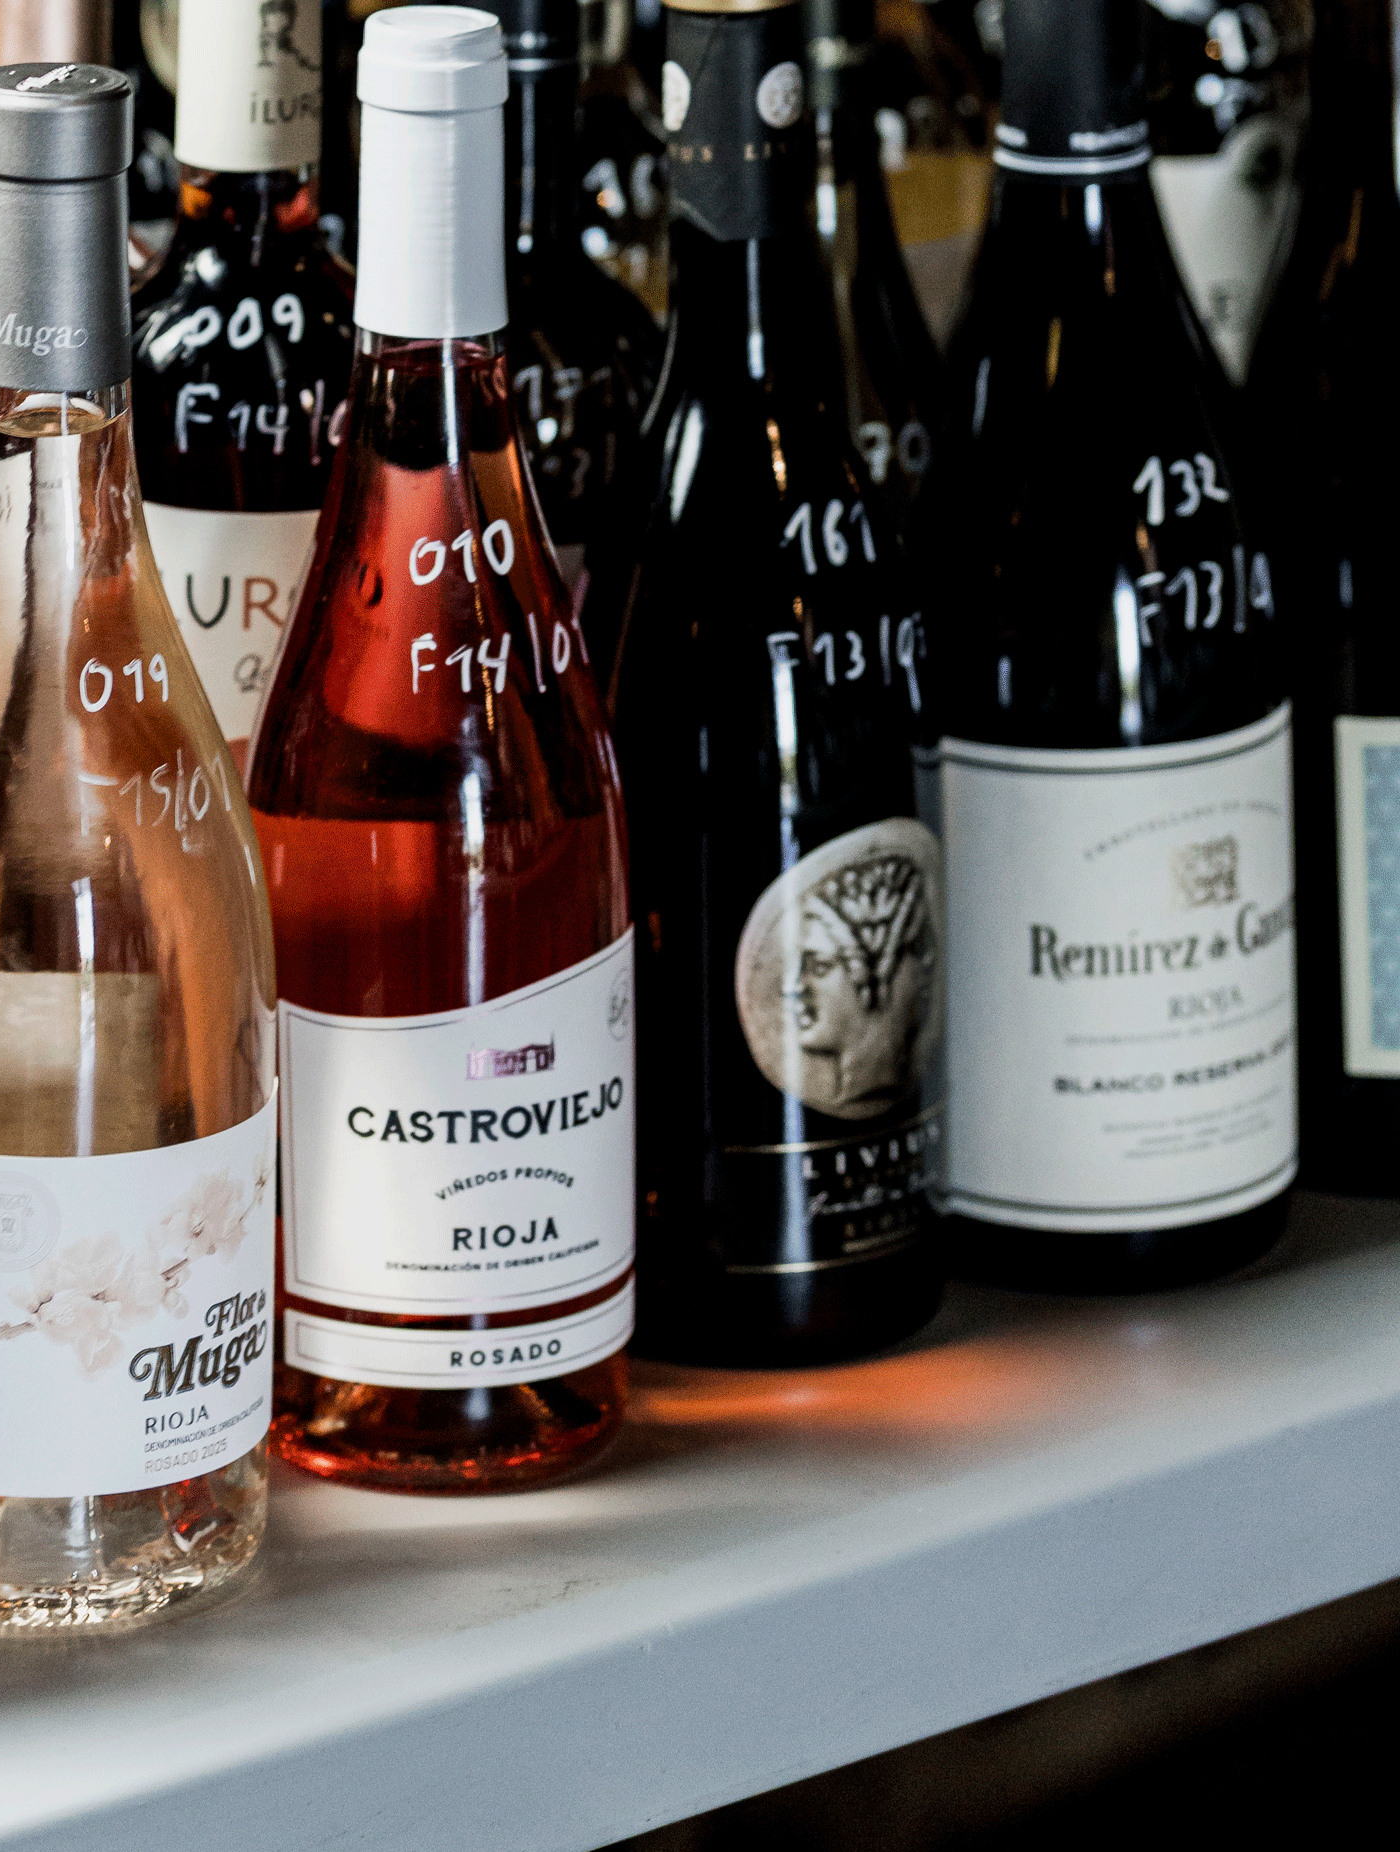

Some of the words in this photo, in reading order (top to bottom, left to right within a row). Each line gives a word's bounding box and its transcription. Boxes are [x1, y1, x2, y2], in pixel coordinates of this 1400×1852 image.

[1132, 452, 1230, 526] 132
[780, 498, 877, 575] 161
[347, 1076, 623, 1144] CASTROVIEJO
[435, 1169, 509, 1200] VIÑEDOS
[515, 1167, 575, 1189] PROPIOS
[452, 1216, 559, 1251] RIOJA
[204, 1290, 257, 1339] Flor
[129, 1319, 268, 1402] Muga
[450, 1339, 562, 1368] ROSADO
[144, 1404, 209, 1435] RIOJA
